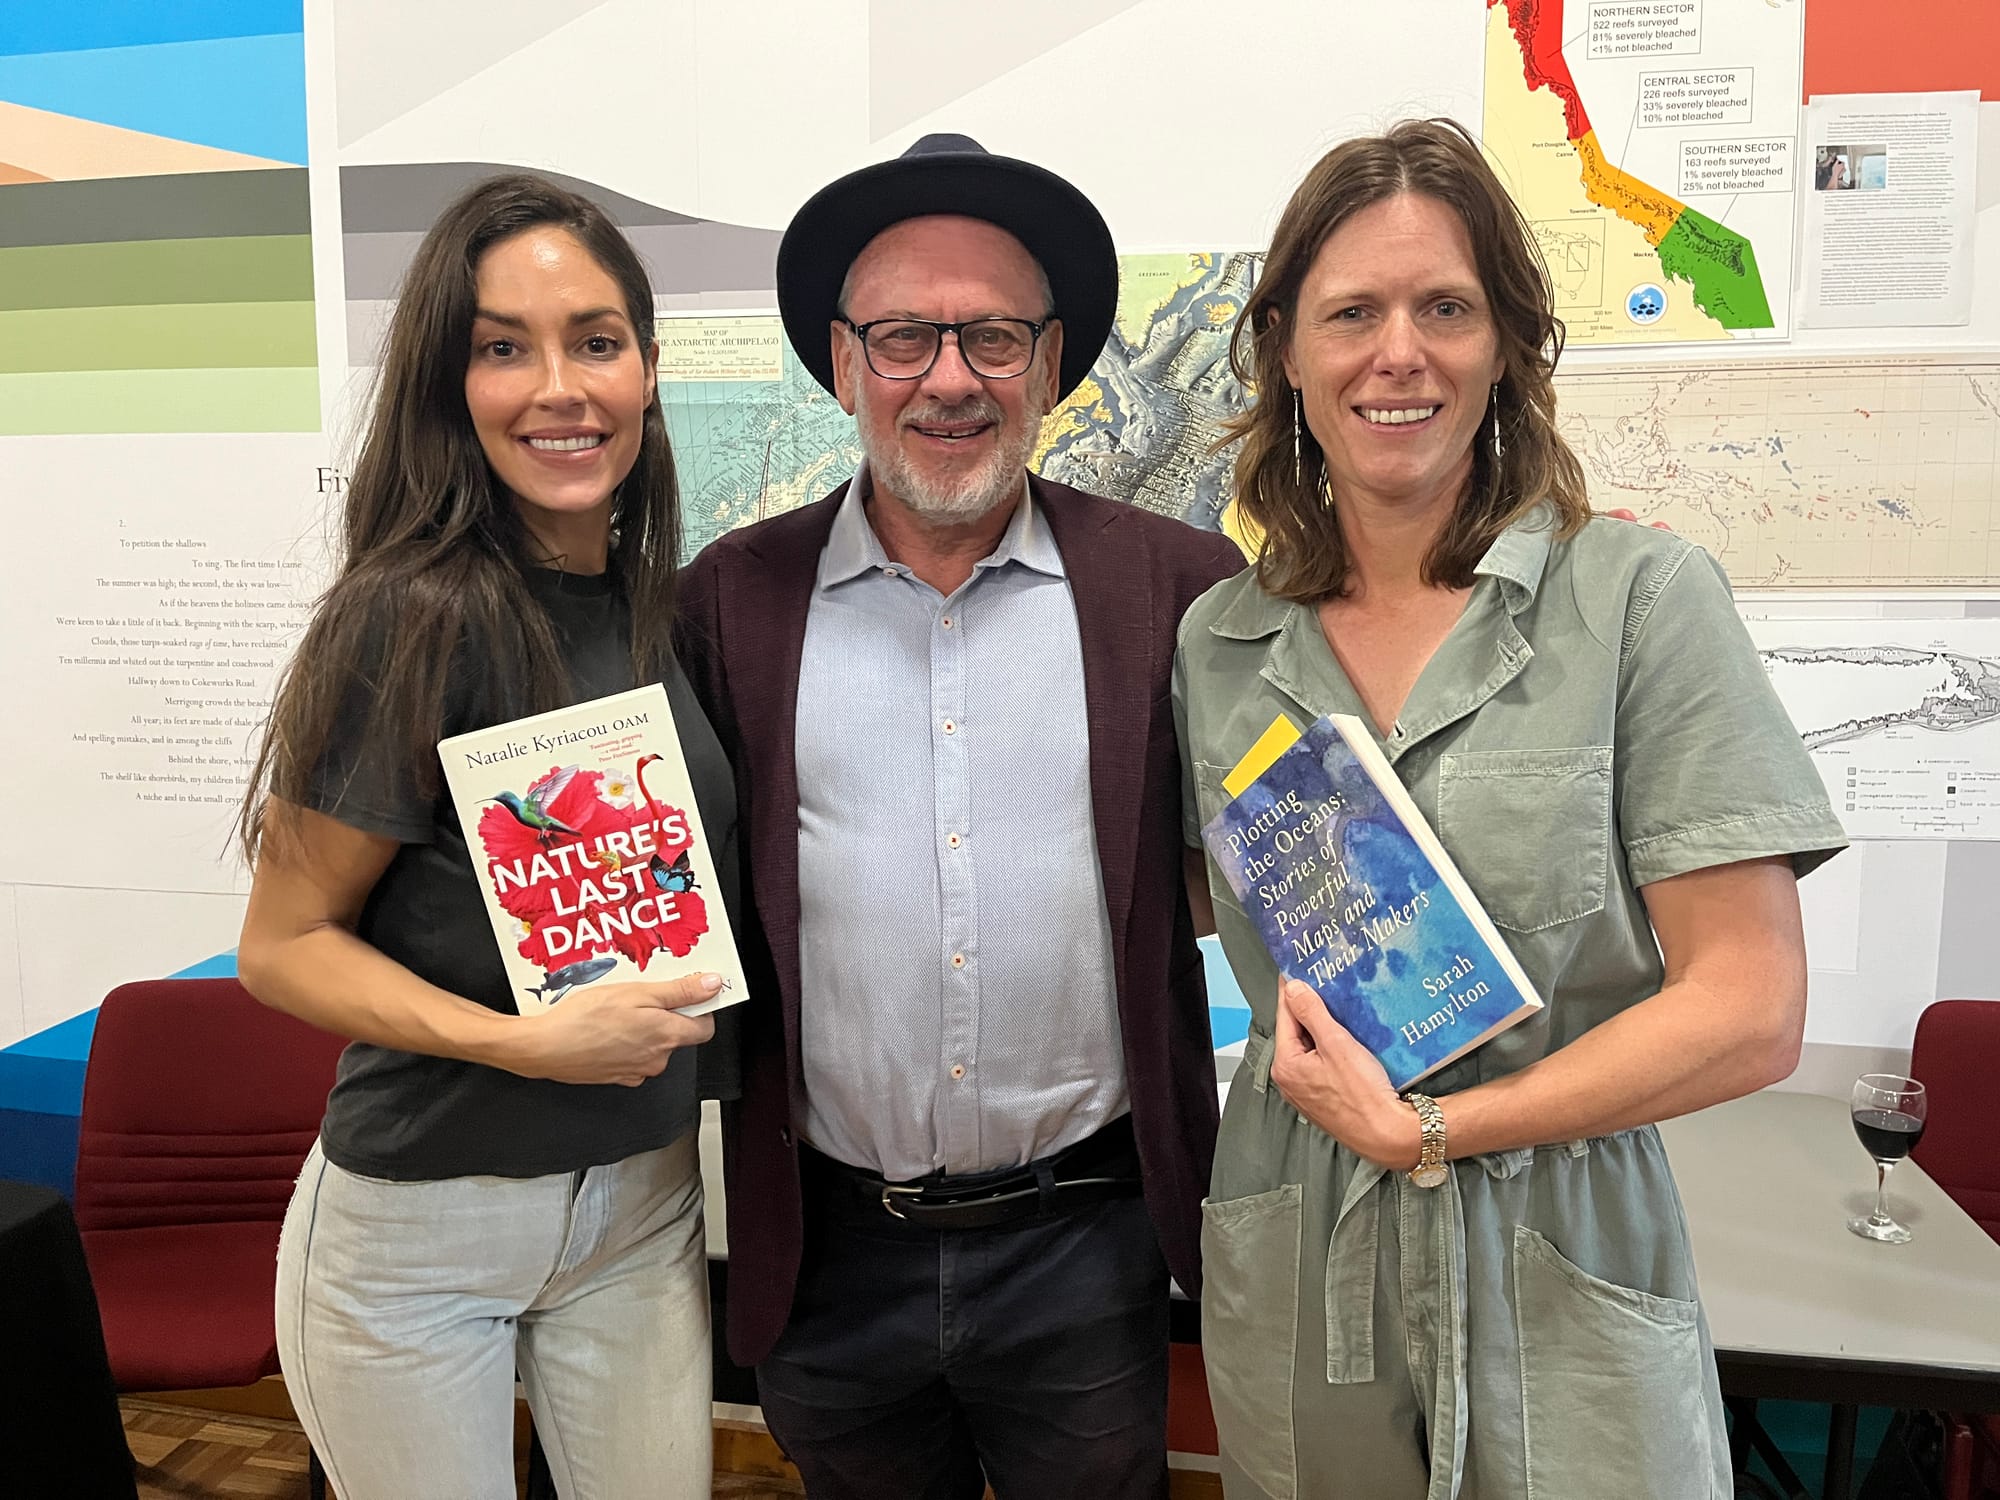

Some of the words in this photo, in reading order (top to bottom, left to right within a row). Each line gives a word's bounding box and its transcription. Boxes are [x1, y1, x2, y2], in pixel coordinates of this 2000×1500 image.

[1594, 6, 1651, 17] NORTHERN
[1653, 4, 1695, 15] SECTOR
[1593, 21, 1610, 30] 522
[1613, 20, 1635, 29] reefs
[1637, 18, 1679, 28] surveyed
[1593, 33, 1613, 42] 81%
[1615, 31, 1653, 41] severely
[1656, 29, 1696, 39] bleached
[1593, 44, 1613, 54] <1%
[1615, 44, 1629, 53] not
[1632, 42, 1673, 52] bleached
[1644, 76, 1691, 87] CENTRAL
[1694, 74, 1736, 85] SECTOR
[1644, 90, 1661, 99] 226
[1663, 89, 1685, 98] reefs
[1688, 87, 1729, 98] surveyed
[1643, 102, 1663, 111] 33%
[1666, 100, 1704, 111] severely
[1706, 98, 1747, 108] bleached
[1643, 114, 1662, 123] 10%
[1666, 113, 1680, 122] not
[1682, 111, 1723, 121] bleached
[1685, 145, 1742, 156] SOUTHERN
[1744, 143, 1787, 153] SECTOR
[1685, 159, 1702, 167] 163
[1704, 158, 1727, 167] reefs
[1729, 156, 1771, 167] surveyed
[1685, 170, 1698, 179] 1%
[1701, 169, 1739, 180] severely
[1742, 167, 1783, 177] bleached
[1683, 182, 1703, 191] 25%
[1706, 182, 1720, 190] not
[1723, 180, 1764, 189] bleached
[671, 338, 718, 347] ANTARCTIC
[720, 337, 779, 346] ARCHIPELAGO
[466, 742, 529, 769] Natalie
[532, 724, 608, 754] Kyriacou
[613, 713, 649, 731] OAM
[1226, 788, 1303, 857] Plotting
[1245, 850, 1275, 883] the
[1275, 790, 1347, 853] Oceans:
[493, 814, 688, 893] NATURE'S
[1258, 858, 1317, 909] Stories
[1320, 829, 1340, 865] of
[551, 862, 649, 917] LAST
[1273, 861, 1353, 936] Powerful
[541, 893, 681, 958] DANCE
[1291, 920, 1340, 963] Maps
[1344, 884, 1377, 923] and
[1307, 940, 1361, 989] Their
[1360, 890, 1431, 953] Makers
[1422, 954, 1476, 999] Sarah
[1401, 979, 1491, 1047] Hamylton
